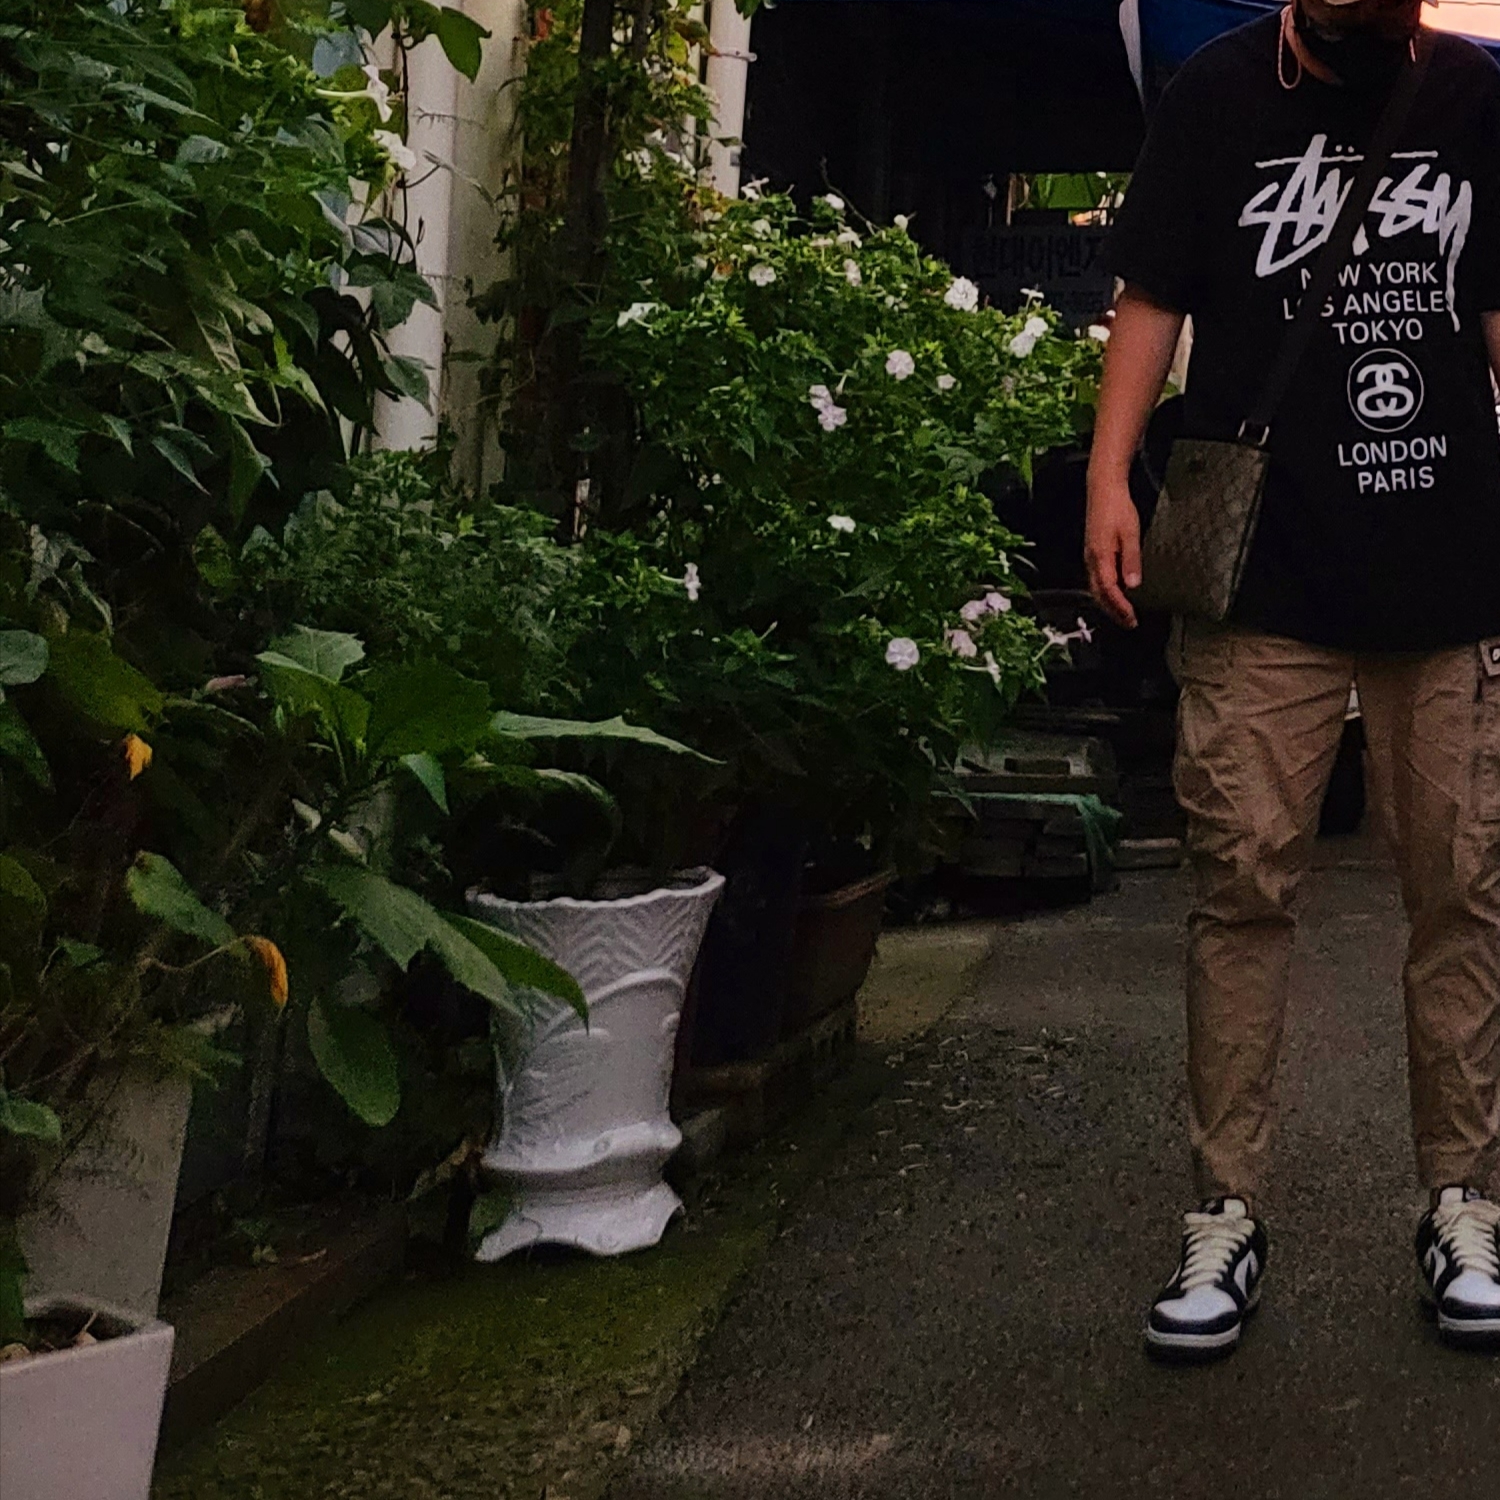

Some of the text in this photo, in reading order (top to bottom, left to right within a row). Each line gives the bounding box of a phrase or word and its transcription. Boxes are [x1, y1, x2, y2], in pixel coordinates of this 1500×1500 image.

[1368, 261, 1439, 286] YORK
[1282, 295, 1336, 320] LS
[1331, 317, 1424, 345] TOKYO
[1337, 435, 1448, 467] LONDON
[1357, 466, 1436, 495] PARIS
